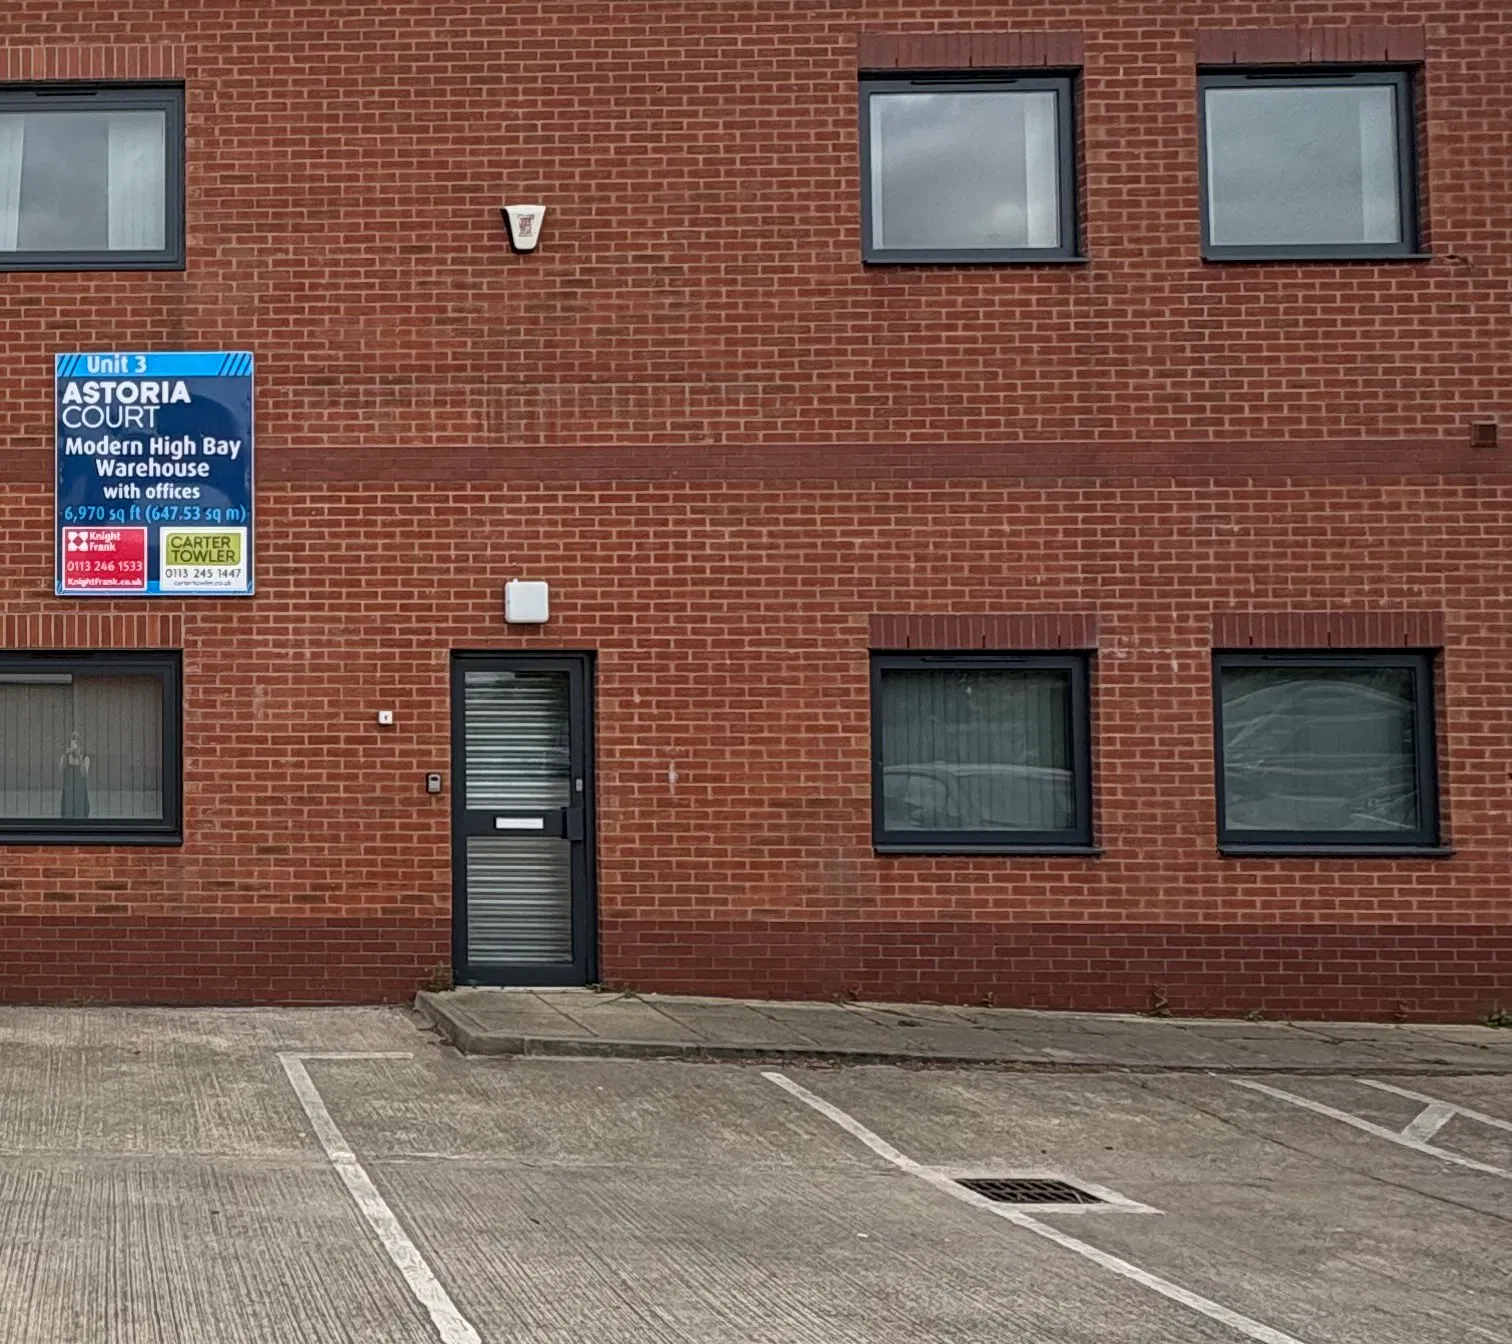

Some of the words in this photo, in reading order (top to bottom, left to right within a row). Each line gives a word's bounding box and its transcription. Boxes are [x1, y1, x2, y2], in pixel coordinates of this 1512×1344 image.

[87, 354, 128, 374] Unit
[134, 355, 147, 373] 3
[62, 380, 192, 405] ASTORIA
[62, 405, 161, 429] COURT
[65, 435, 143, 456] Modern
[149, 436, 197, 461] High
[202, 437, 242, 460] Bay
[95, 457, 210, 478] Warehouse
[103, 483, 141, 500] with
[145, 483, 201, 500] offices
[64, 506, 106, 523] 6,970
[109, 508, 125, 523] sq
[129, 505, 141, 521] ft
[145, 504, 201, 524] (647.53
[204, 508, 221, 523] sq
[225, 504, 247, 523] m)
[89, 531, 121, 543] Knight
[171, 536, 231, 549] CARTER
[89, 542, 116, 552] Frank
[171, 549, 236, 563] TOWLER
[67, 560, 91, 572] 0113
[93, 560, 115, 572] 246
[117, 560, 143, 572] 1533
[165, 568, 188, 578] 0113
[193, 568, 213, 578] 245
[217, 568, 242, 578] 1447
